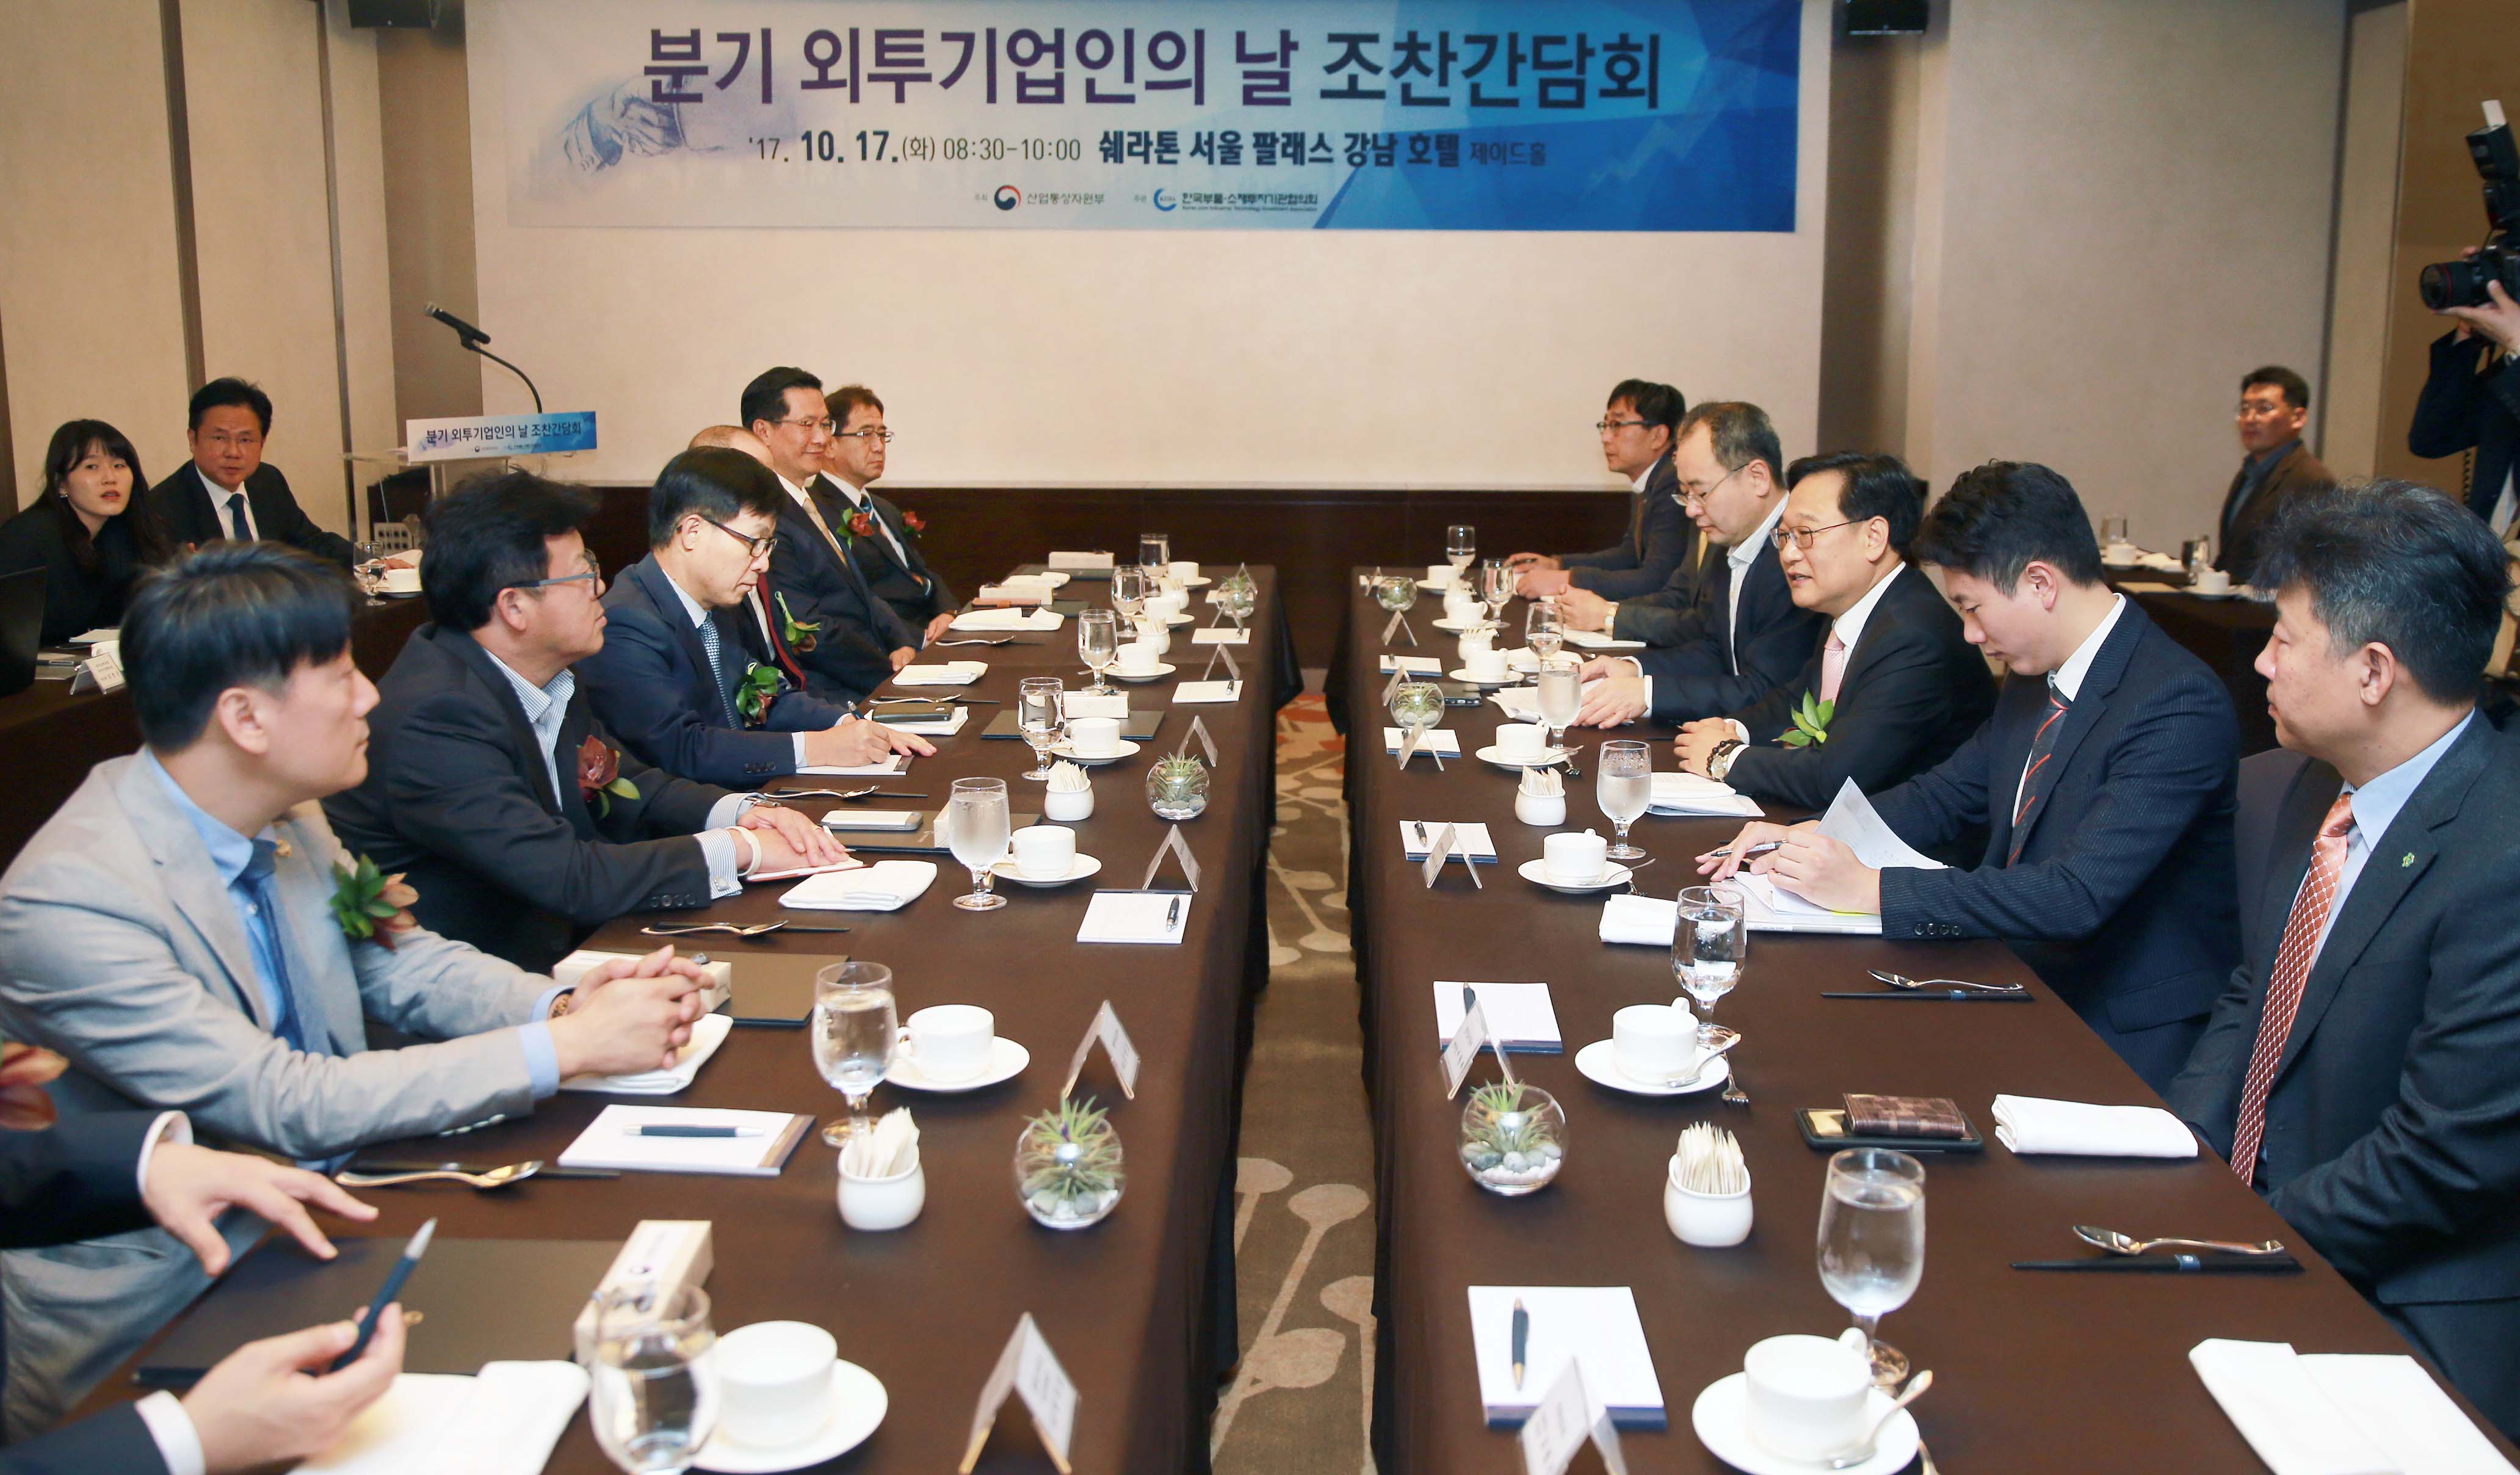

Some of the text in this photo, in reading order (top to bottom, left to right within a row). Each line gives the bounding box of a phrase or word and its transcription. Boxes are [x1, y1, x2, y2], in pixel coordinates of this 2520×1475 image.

[644, 27, 1661, 109] 분기 외투기업인의 날 조찬간담회
[749, 136, 789, 162] '17.
[800, 129, 844, 163] 10.
[1099, 130, 1181, 165] 쉐라톤
[1189, 130, 1244, 165] 서울
[1253, 131, 1334, 166] 팔래스
[1344, 132, 1399, 167] 강남
[1406, 132, 1460, 168] 호텔
[1469, 141, 1546, 167] 제이드홀
[1027, 192, 1105, 205] 산업통상자원부
[426, 422, 582, 443] 분기 외투기업인의 날 조찬간담회
